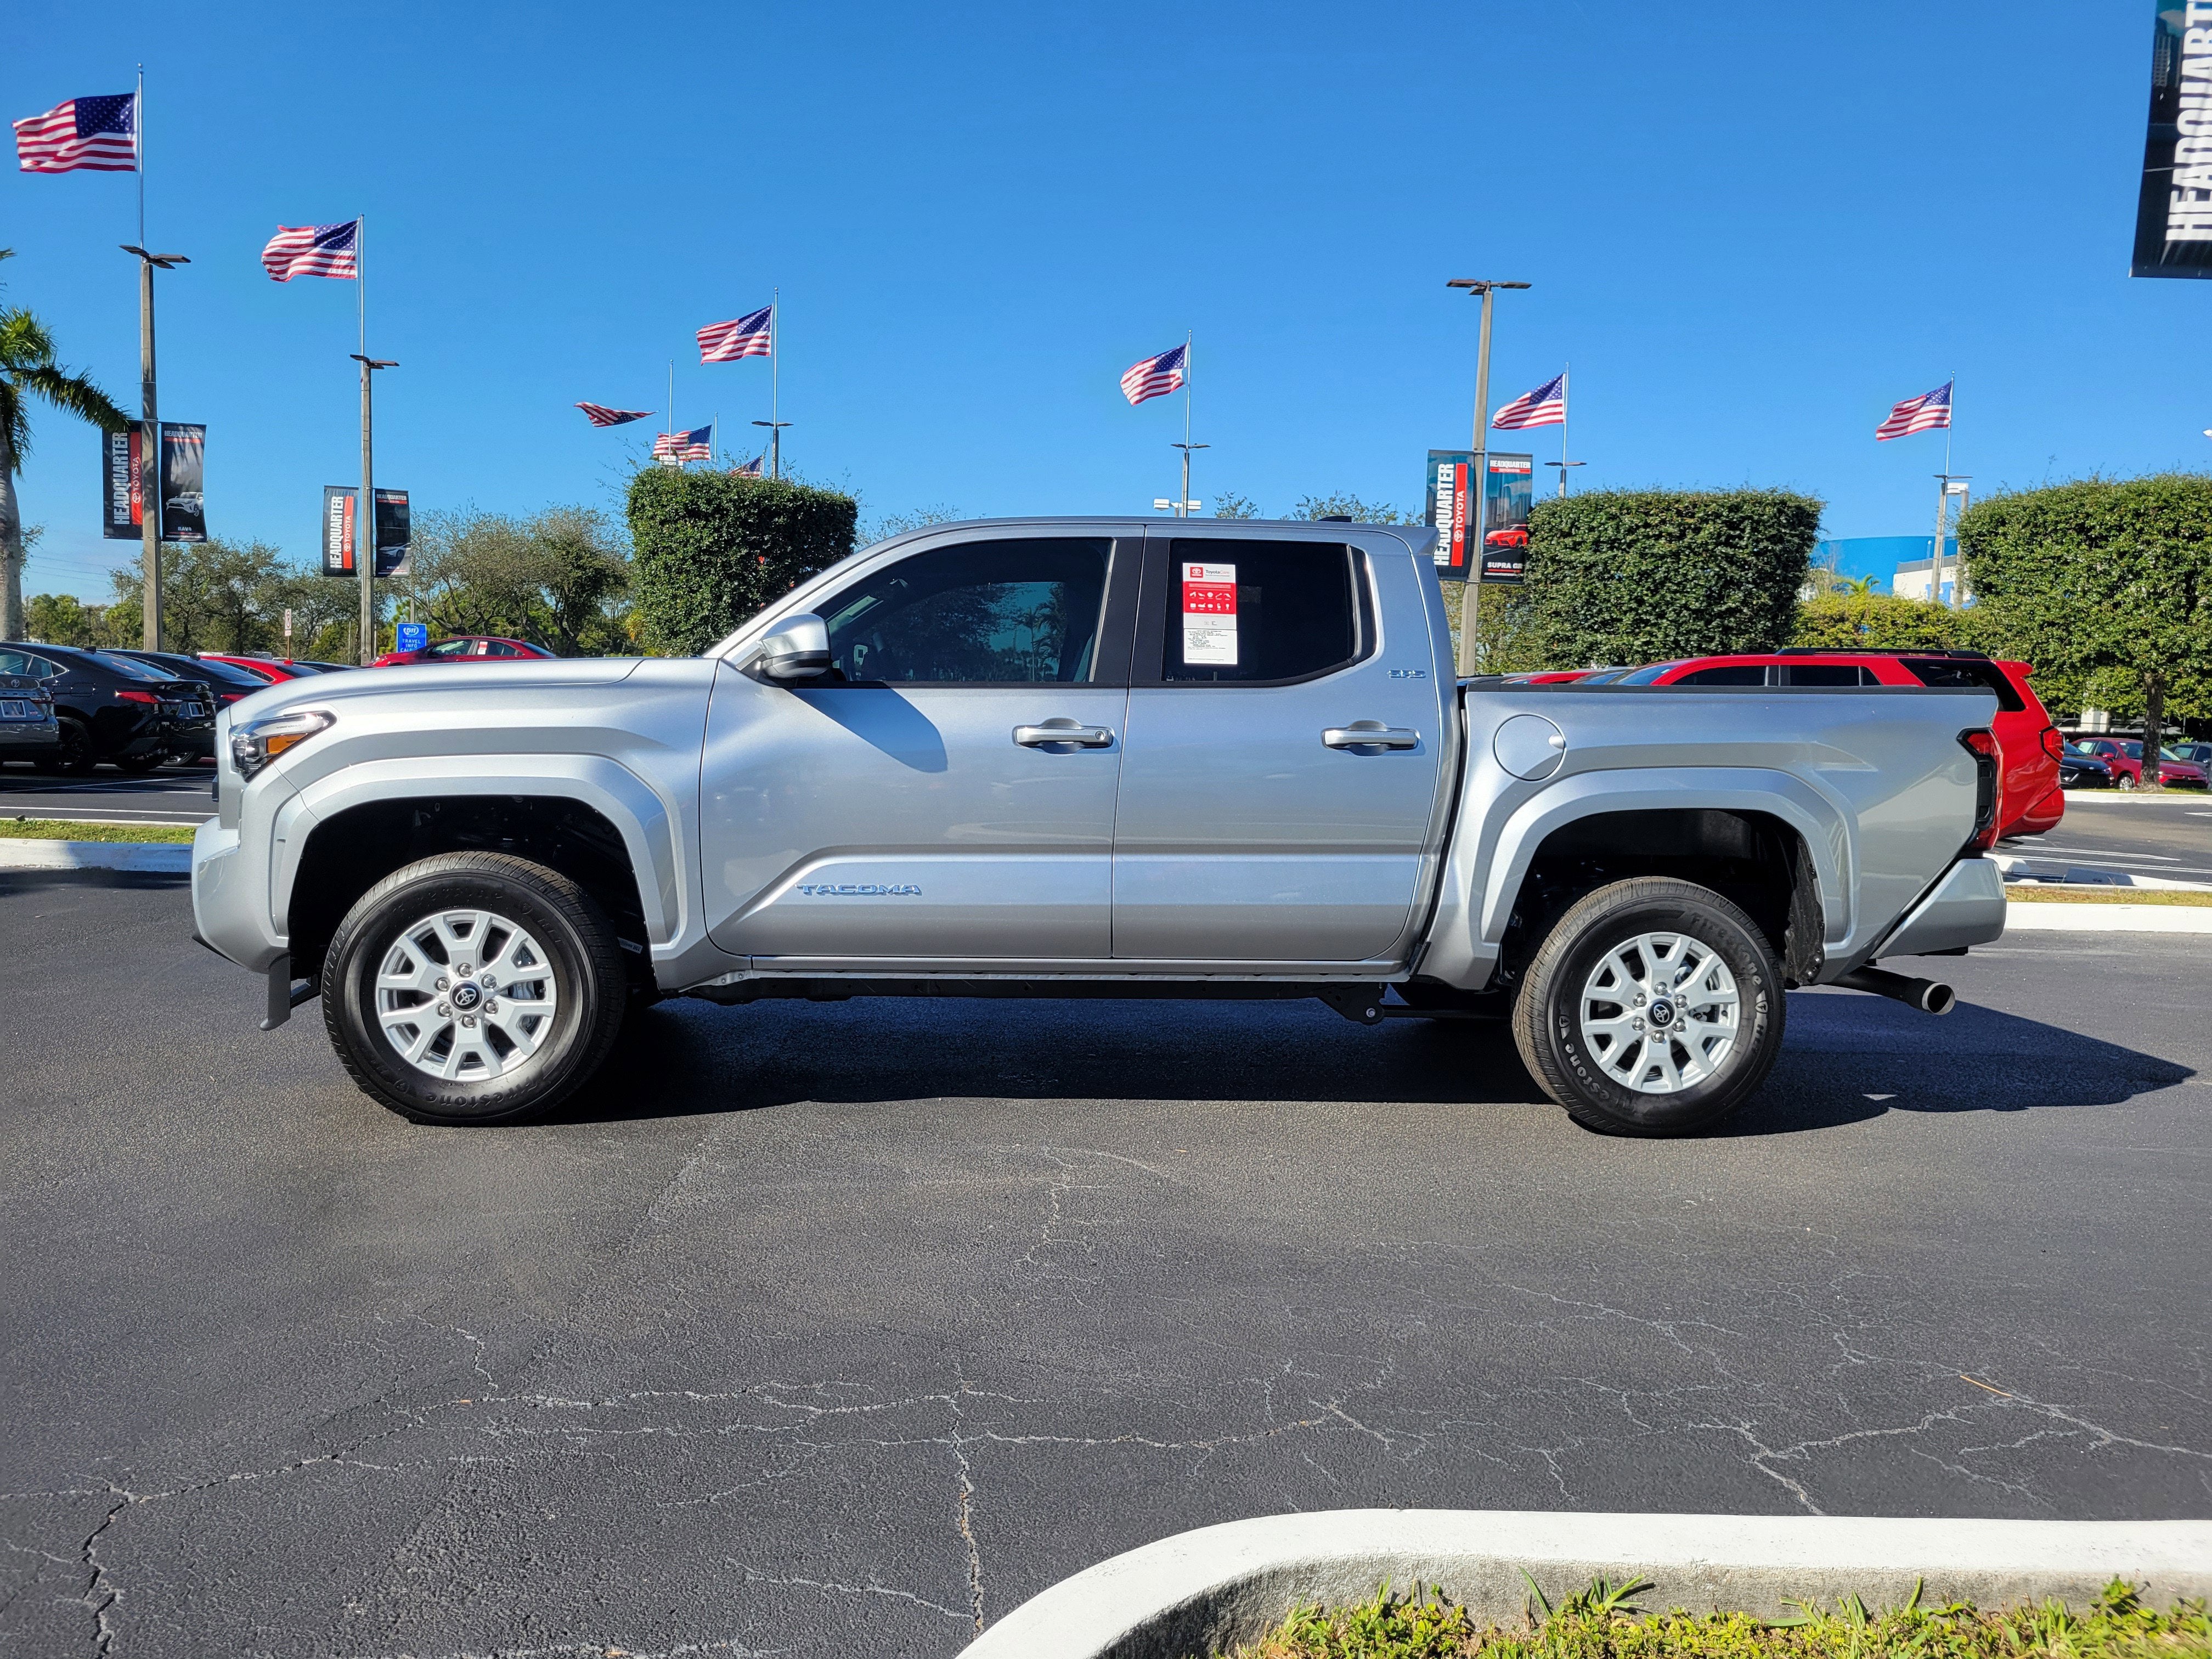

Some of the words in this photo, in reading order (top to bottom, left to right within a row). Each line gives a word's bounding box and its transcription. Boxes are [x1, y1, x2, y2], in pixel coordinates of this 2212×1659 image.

[2165, 0, 2212, 240] HEADQUART
[112, 432, 131, 524] HEADQUARTER
[1455, 490, 1465, 529] TOYOTA
[330, 496, 343, 568] HEADQUARTER
[1434, 464, 1454, 566] HEADQUARTER
[795, 884, 922, 895] TACOMA
[425, 1076, 539, 1108] Firestone
